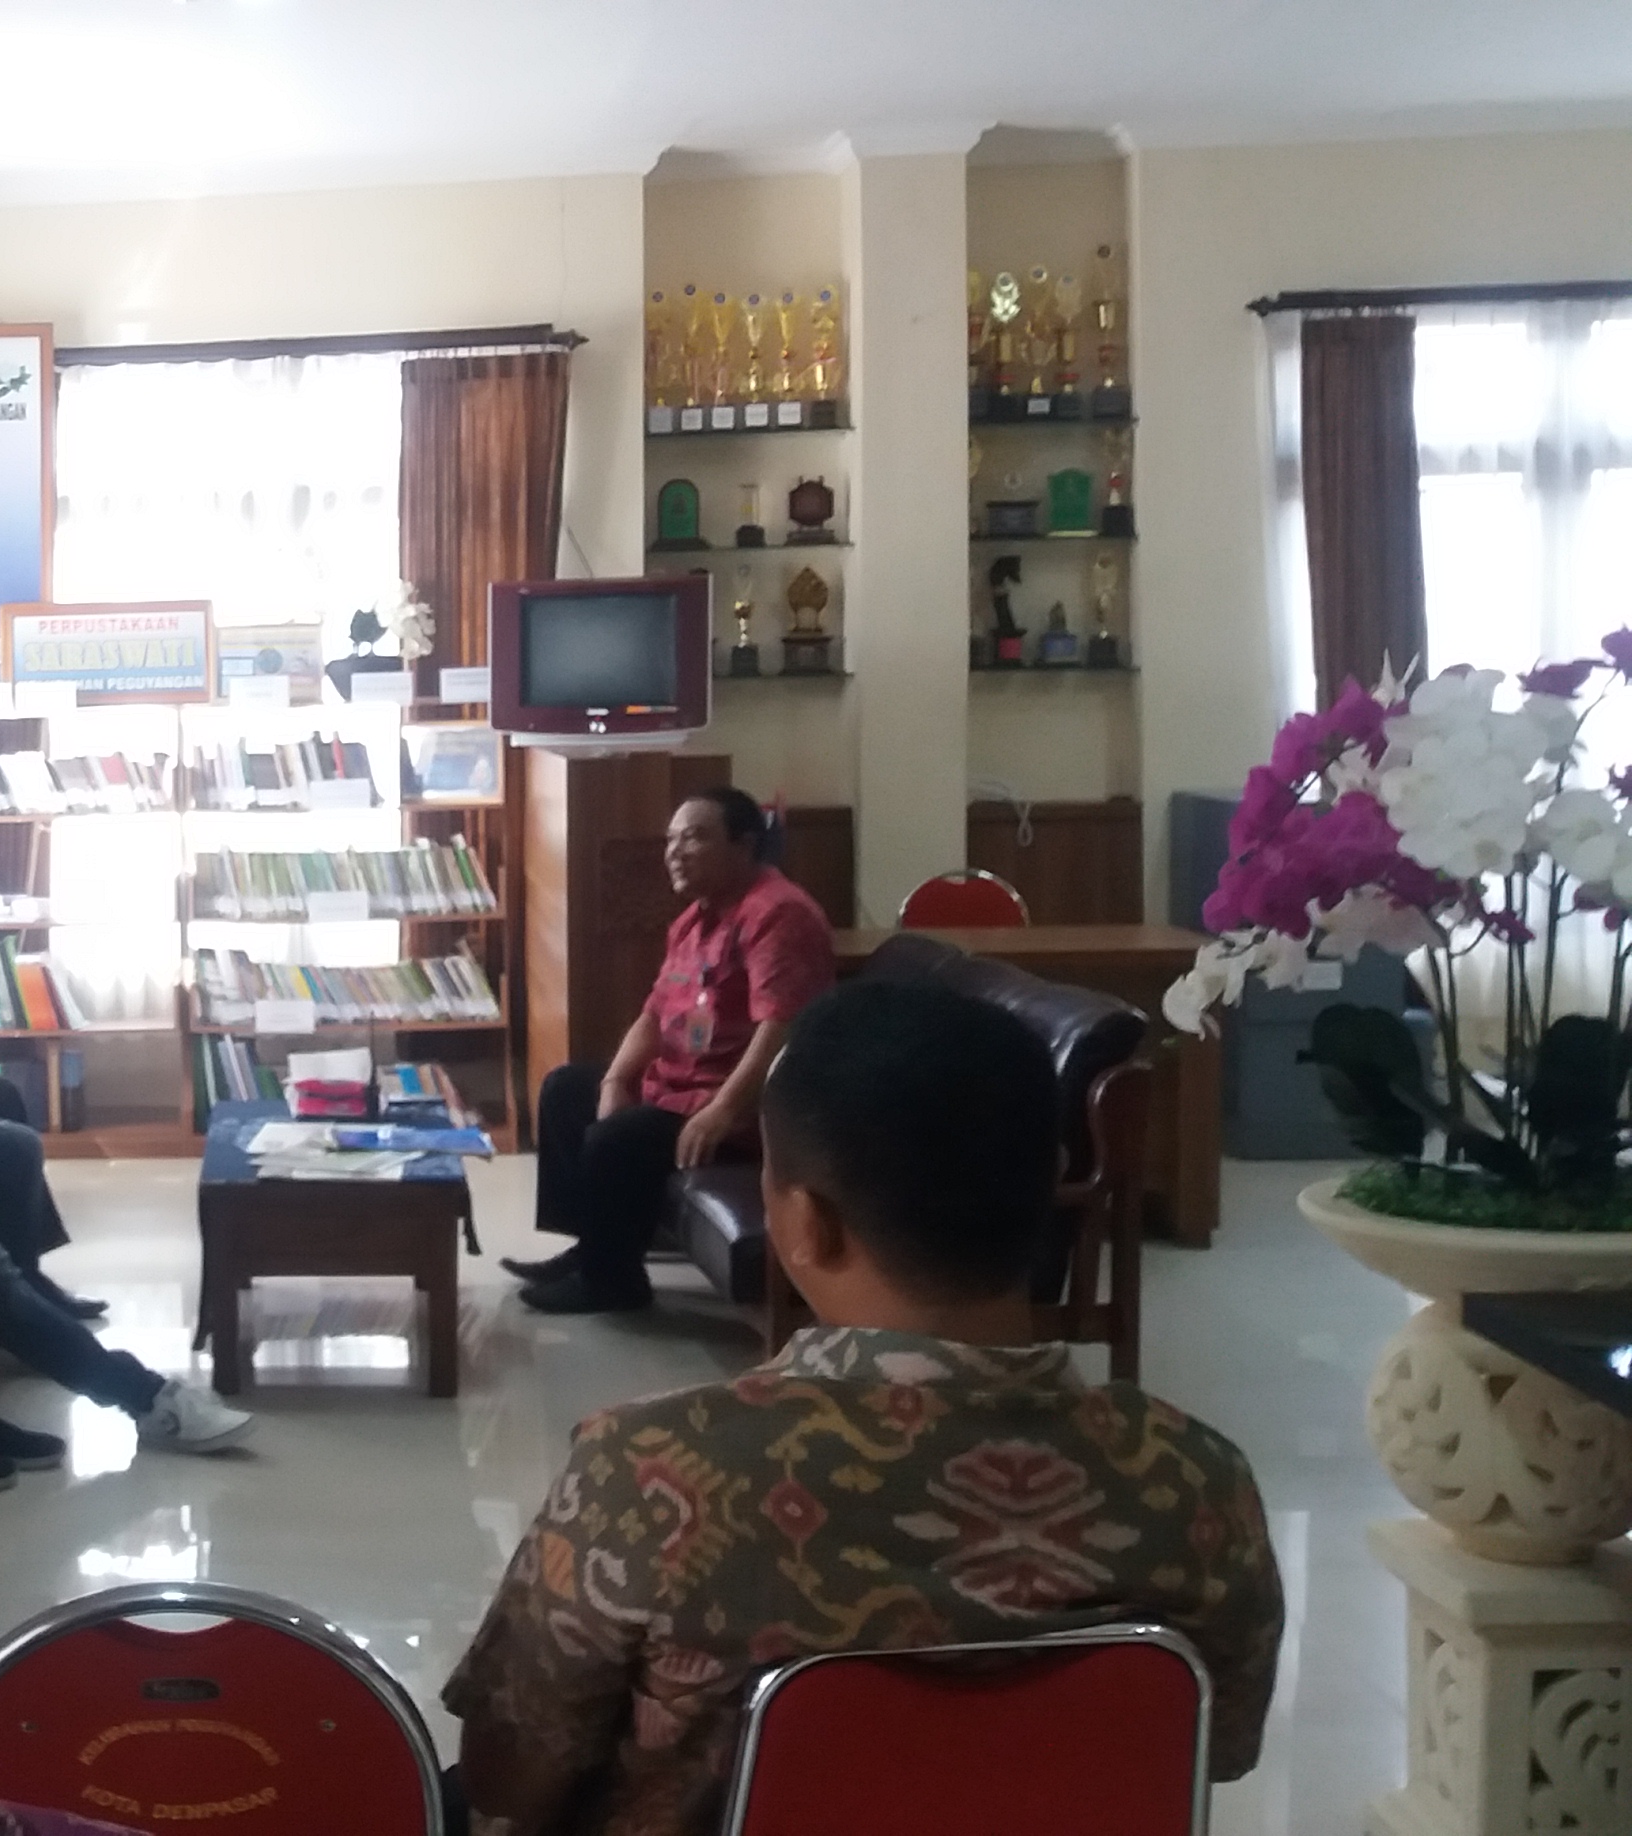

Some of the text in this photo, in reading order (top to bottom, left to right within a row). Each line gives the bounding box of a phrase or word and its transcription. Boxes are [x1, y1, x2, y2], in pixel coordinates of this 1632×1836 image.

[38, 616, 180, 635] PERPUSTAKAAN
[23, 637, 196, 672] SARASWATI
[106, 675, 205, 691] PEGUYANGAN
[82, 1785, 279, 1820] KOTA DENPASAR
